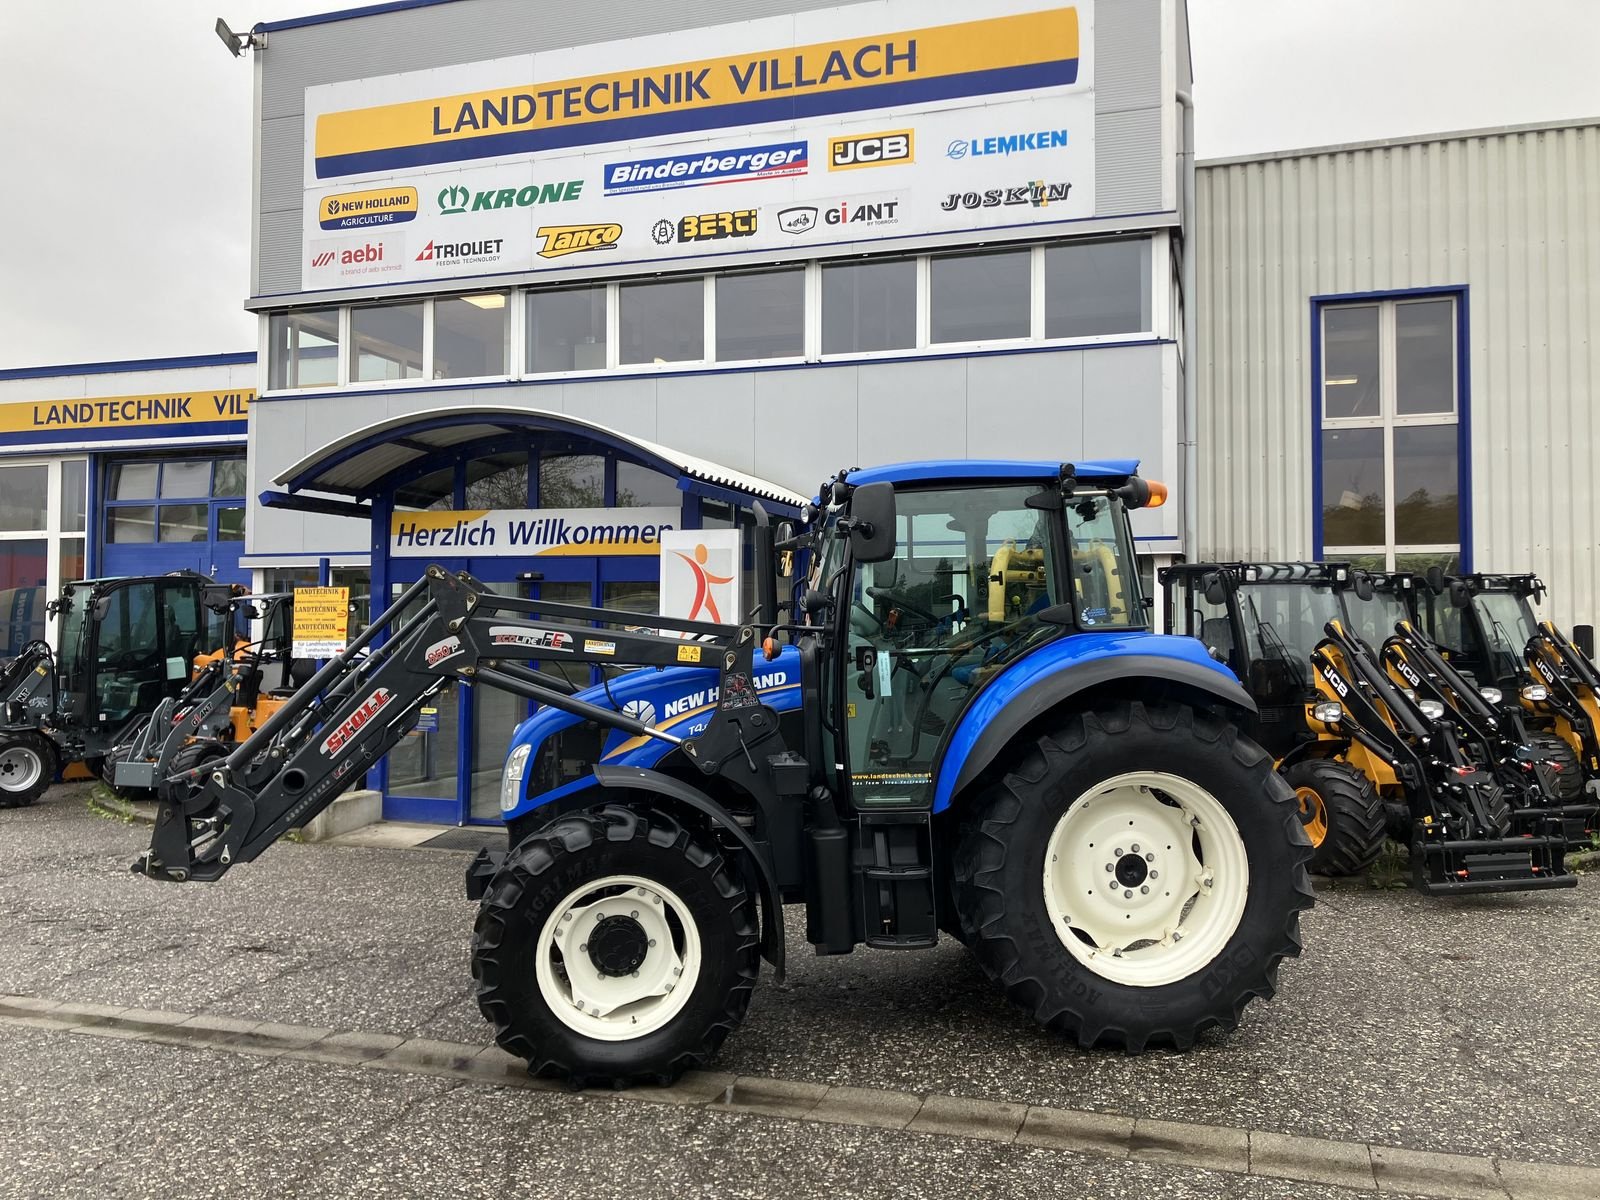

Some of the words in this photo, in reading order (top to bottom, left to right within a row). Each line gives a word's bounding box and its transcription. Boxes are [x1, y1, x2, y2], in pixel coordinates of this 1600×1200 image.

[432, 67, 712, 137] LANDTECHNIK
[729, 40, 918, 95] VILLACH
[834, 134, 908, 164] JCB
[971, 130, 1067, 157] LEMKEN
[610, 147, 803, 184] Binderberger
[341, 200, 364, 212] NEW
[365, 195, 410, 209] HOLLAND
[471, 180, 584, 211] KRONE
[941, 181, 1073, 210] JOSKIN
[340, 213, 394, 228] AGRICULTURE
[434, 239, 503, 259] TRIOLIET
[536, 224, 622, 253] Tanco
[341, 242, 384, 265] aebi
[436, 259, 461, 267] FEEDING
[462, 255, 501, 265] TECHNOLOGY
[33, 397, 192, 426] LANDTECHNIK
[397, 520, 496, 546] Herzlich
[428, 645, 450, 665] 850
[450, 643, 458, 653] P
[1323, 665, 1349, 698] JCB
[1396, 660, 1420, 687] JCB
[1535, 658, 1554, 684] JCB
[664, 690, 704, 719] NEW
[326, 690, 389, 754] STOLL
[851, 772, 932, 780] www.landtechnik.co.at
